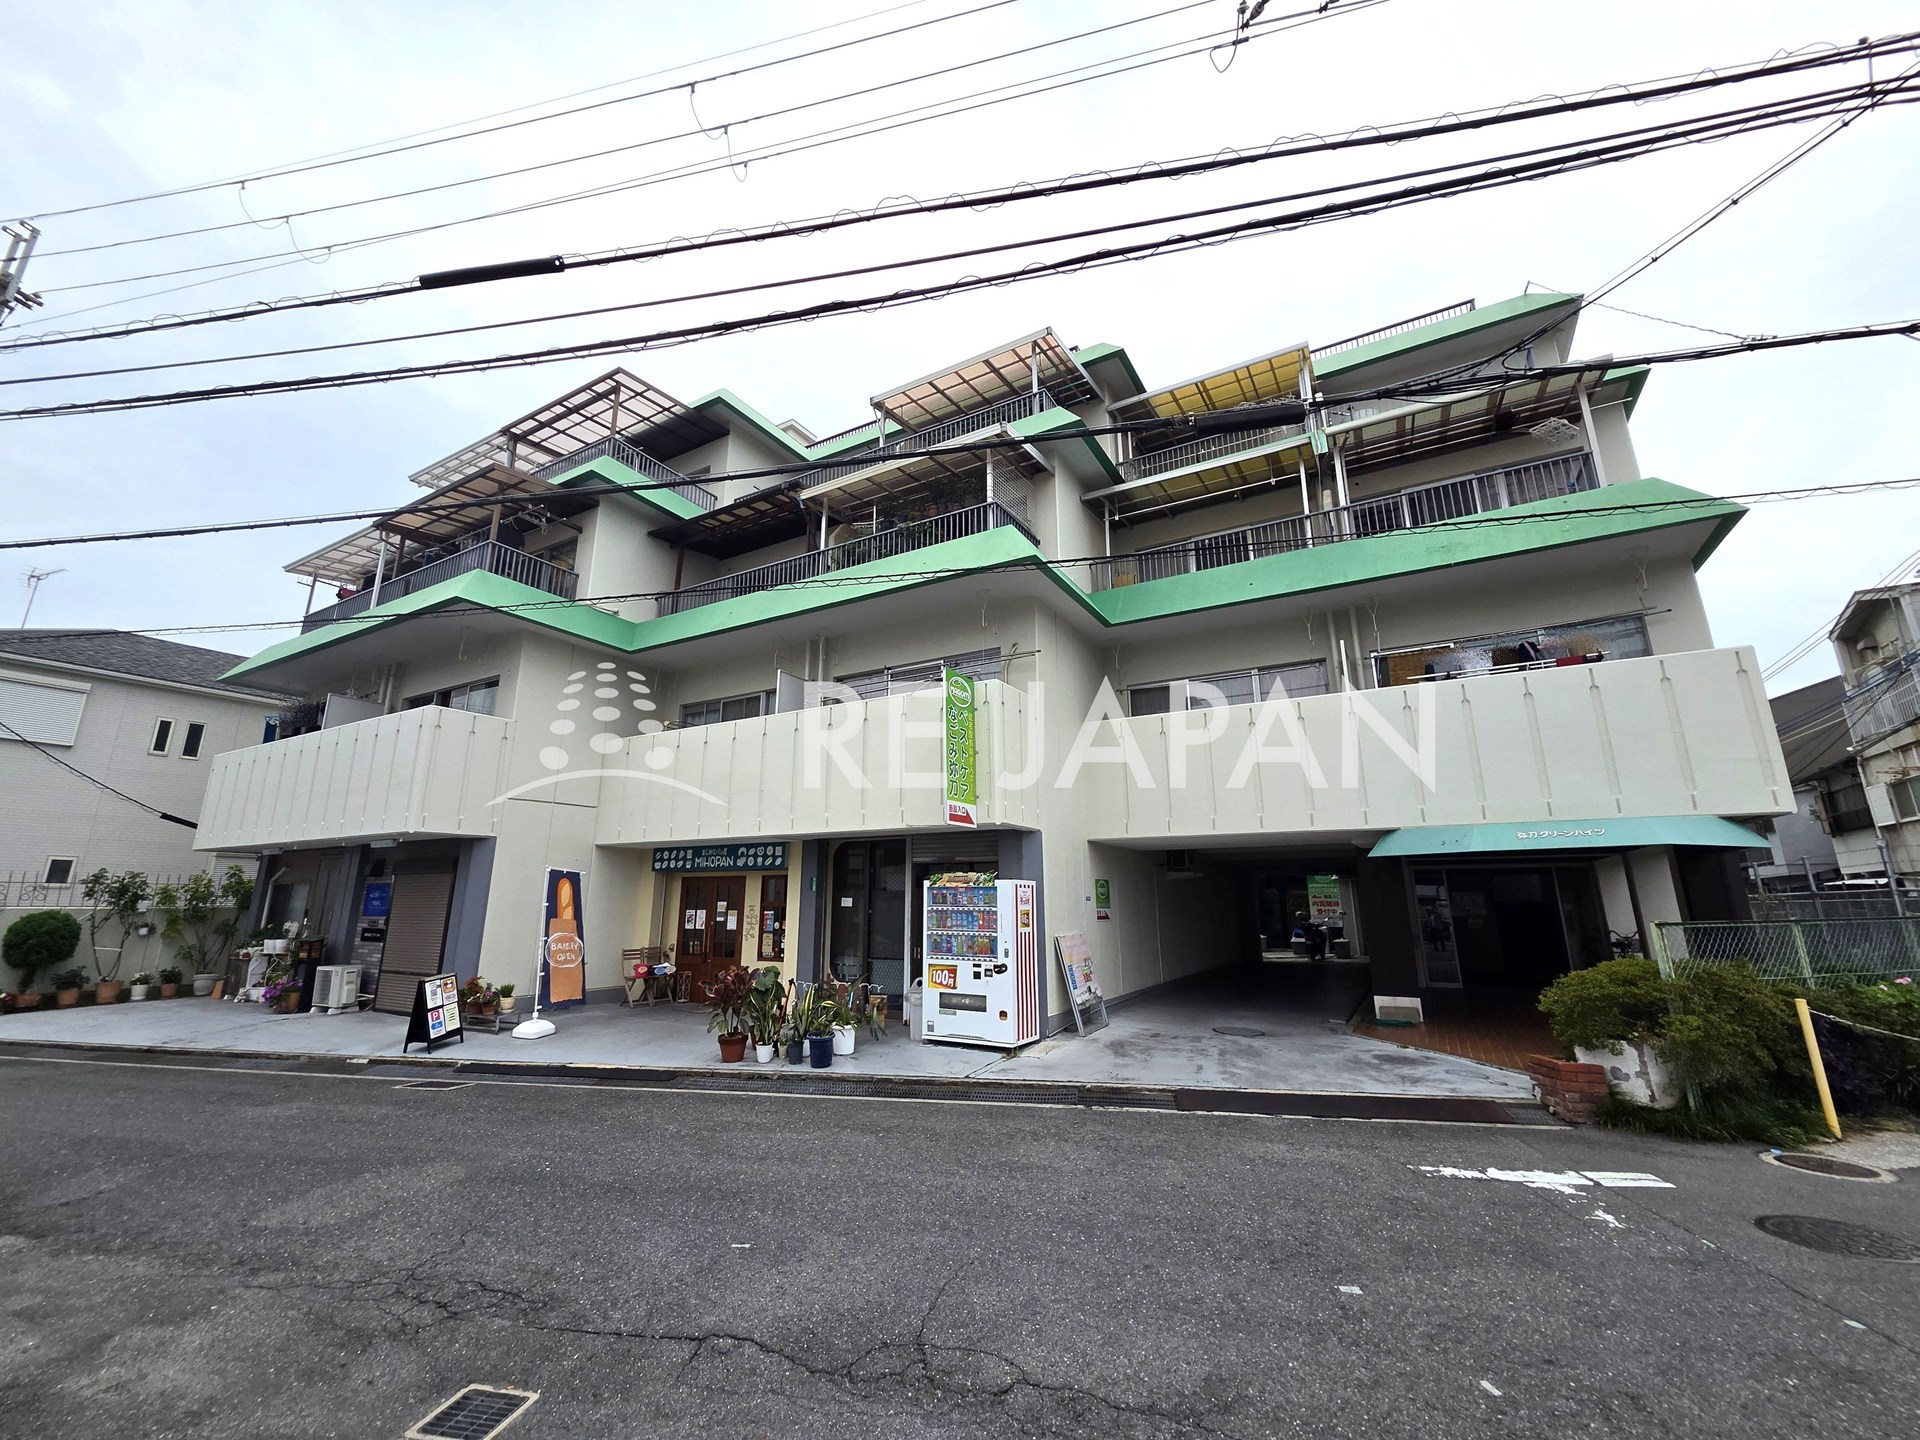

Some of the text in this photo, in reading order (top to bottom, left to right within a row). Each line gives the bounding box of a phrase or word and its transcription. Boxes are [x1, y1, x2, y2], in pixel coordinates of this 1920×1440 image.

[948, 705, 959, 798] なごみ弥刀
[694, 856, 734, 868] MIHOPAN
[556, 952, 576, 962] OPEN
